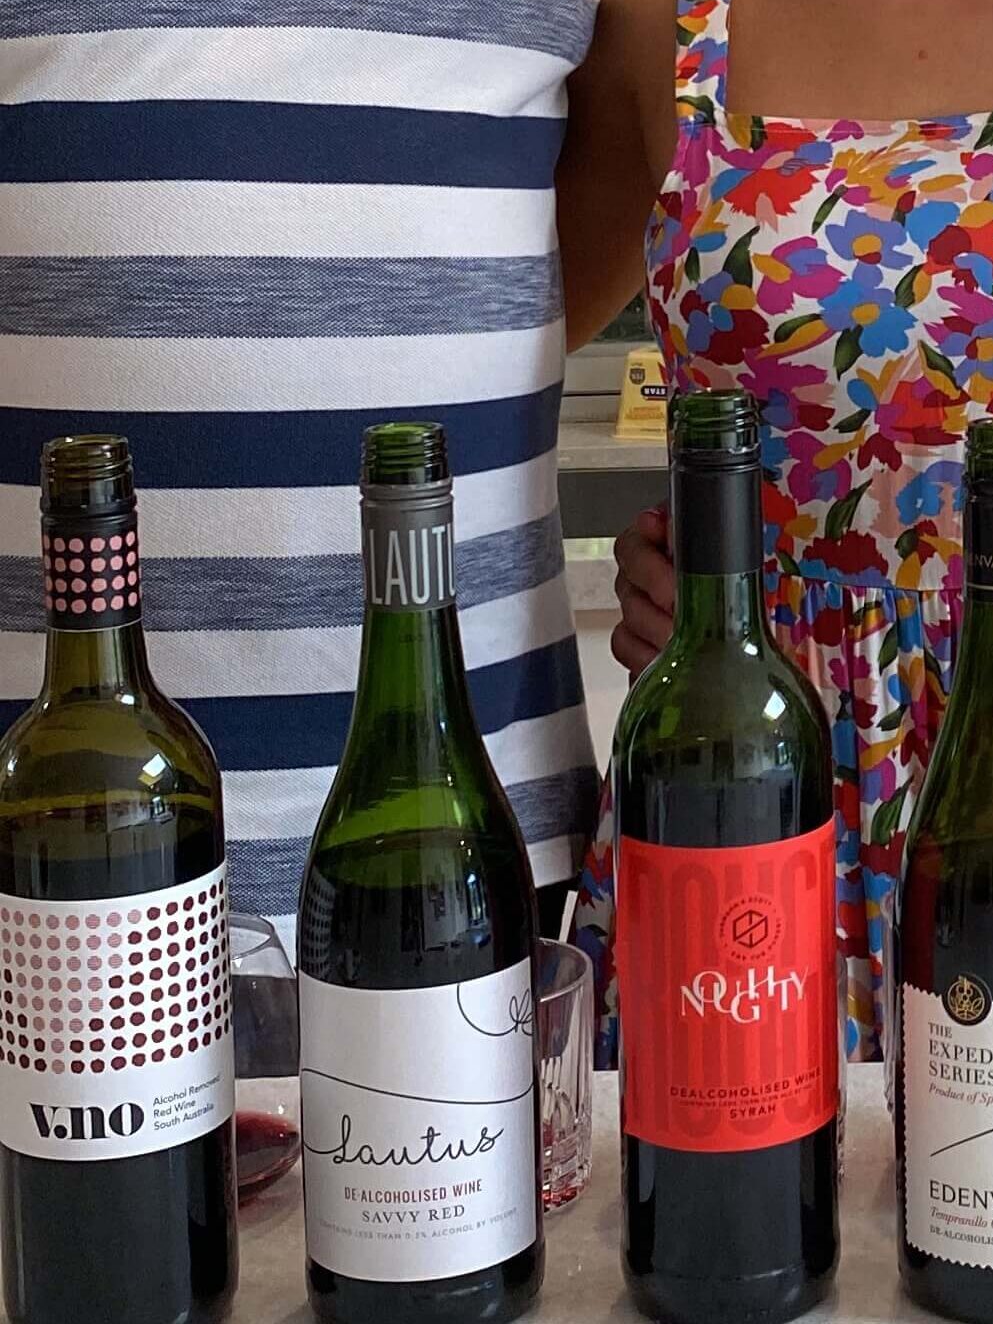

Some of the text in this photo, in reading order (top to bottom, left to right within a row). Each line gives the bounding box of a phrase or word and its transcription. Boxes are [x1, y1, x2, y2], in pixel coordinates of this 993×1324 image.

[928, 1022, 952, 1038] THE
[153, 1087, 187, 1107] Alcohol
[928, 1082, 964, 1102] Product
[966, 1091, 979, 1106] of
[153, 1100, 196, 1118] Red Wine
[729, 1104, 776, 1120] SYRAH
[153, 1116, 180, 1131] South
[453, 1178, 483, 1198] WINE
[362, 1204, 466, 1225] SAVVY RED
[930, 1207, 987, 1228] Tempranillo
[431, 1224, 474, 1239] ALCOHOL
